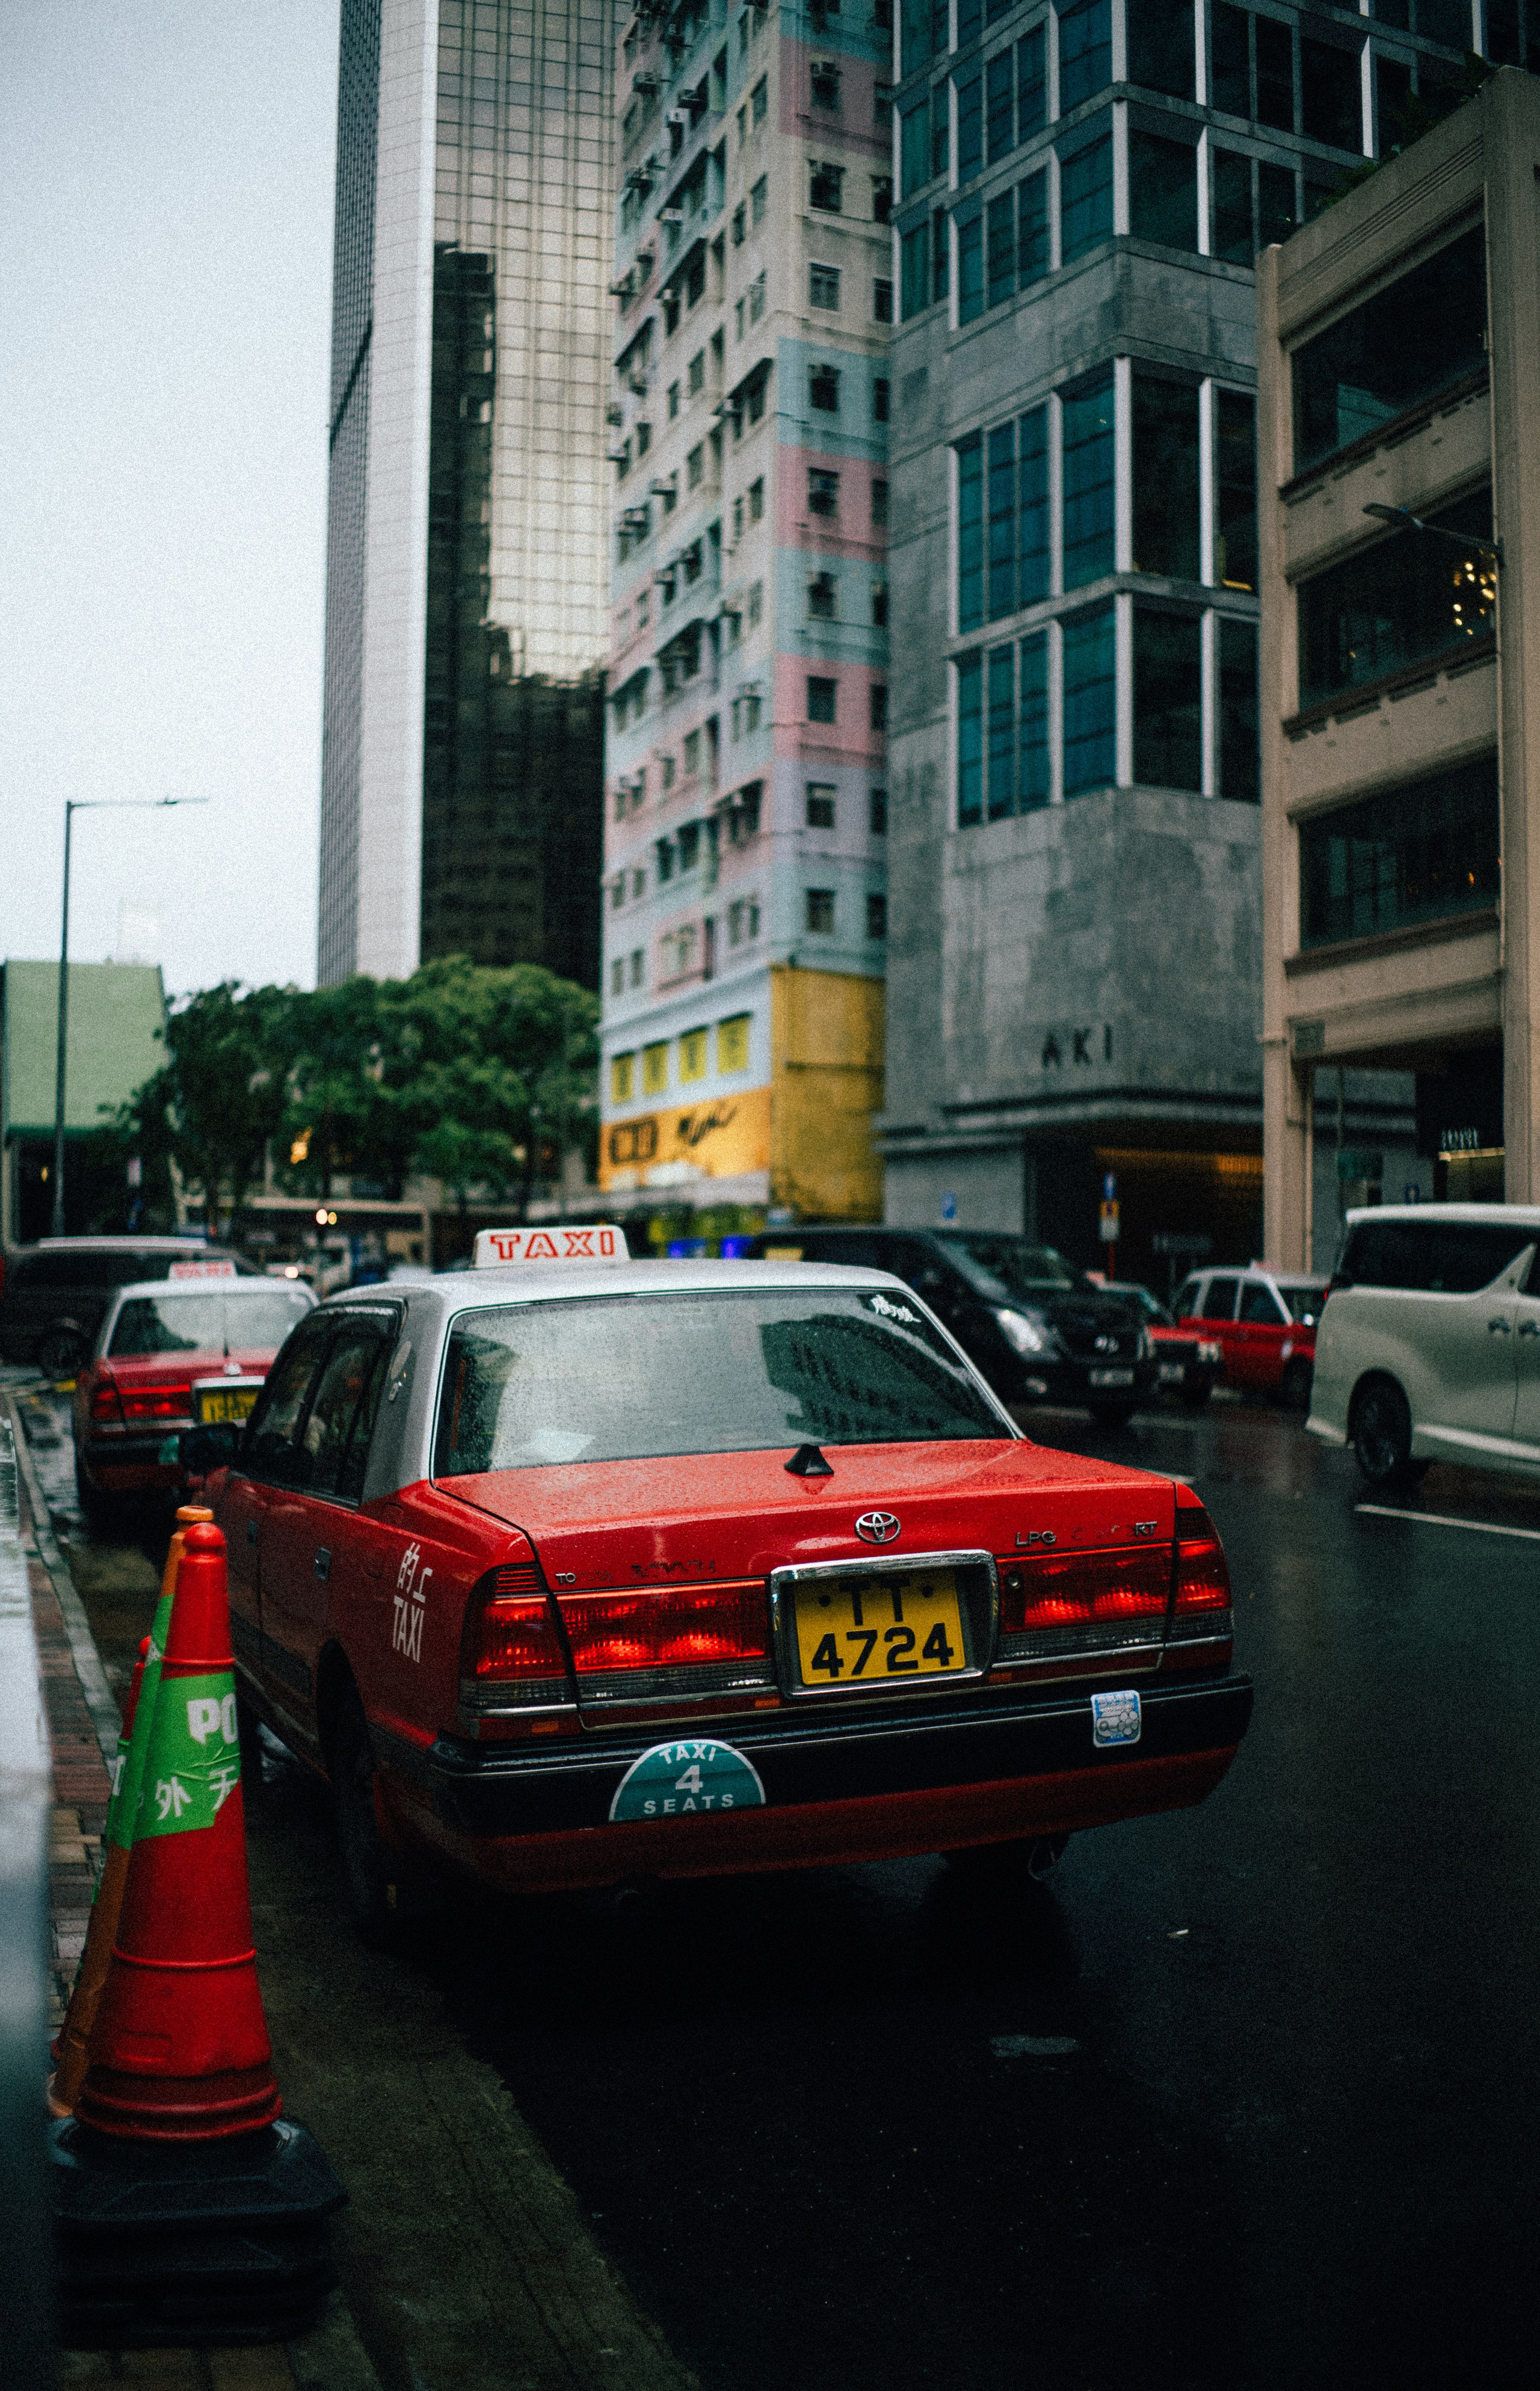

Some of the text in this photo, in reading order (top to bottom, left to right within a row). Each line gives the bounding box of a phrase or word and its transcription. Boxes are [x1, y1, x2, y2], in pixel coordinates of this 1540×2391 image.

[1041, 1023, 1113, 1068] AKI
[490, 1231, 615, 1260] TAXI
[1015, 1530, 1056, 1547] LPG
[839, 1577, 911, 1626] TT
[392, 1595, 425, 1663] TAXI
[812, 1622, 955, 1678] 4724
[659, 1744, 716, 1765] TAXI
[675, 1764, 704, 1794] 4
[643, 1794, 735, 1814] SEATS
